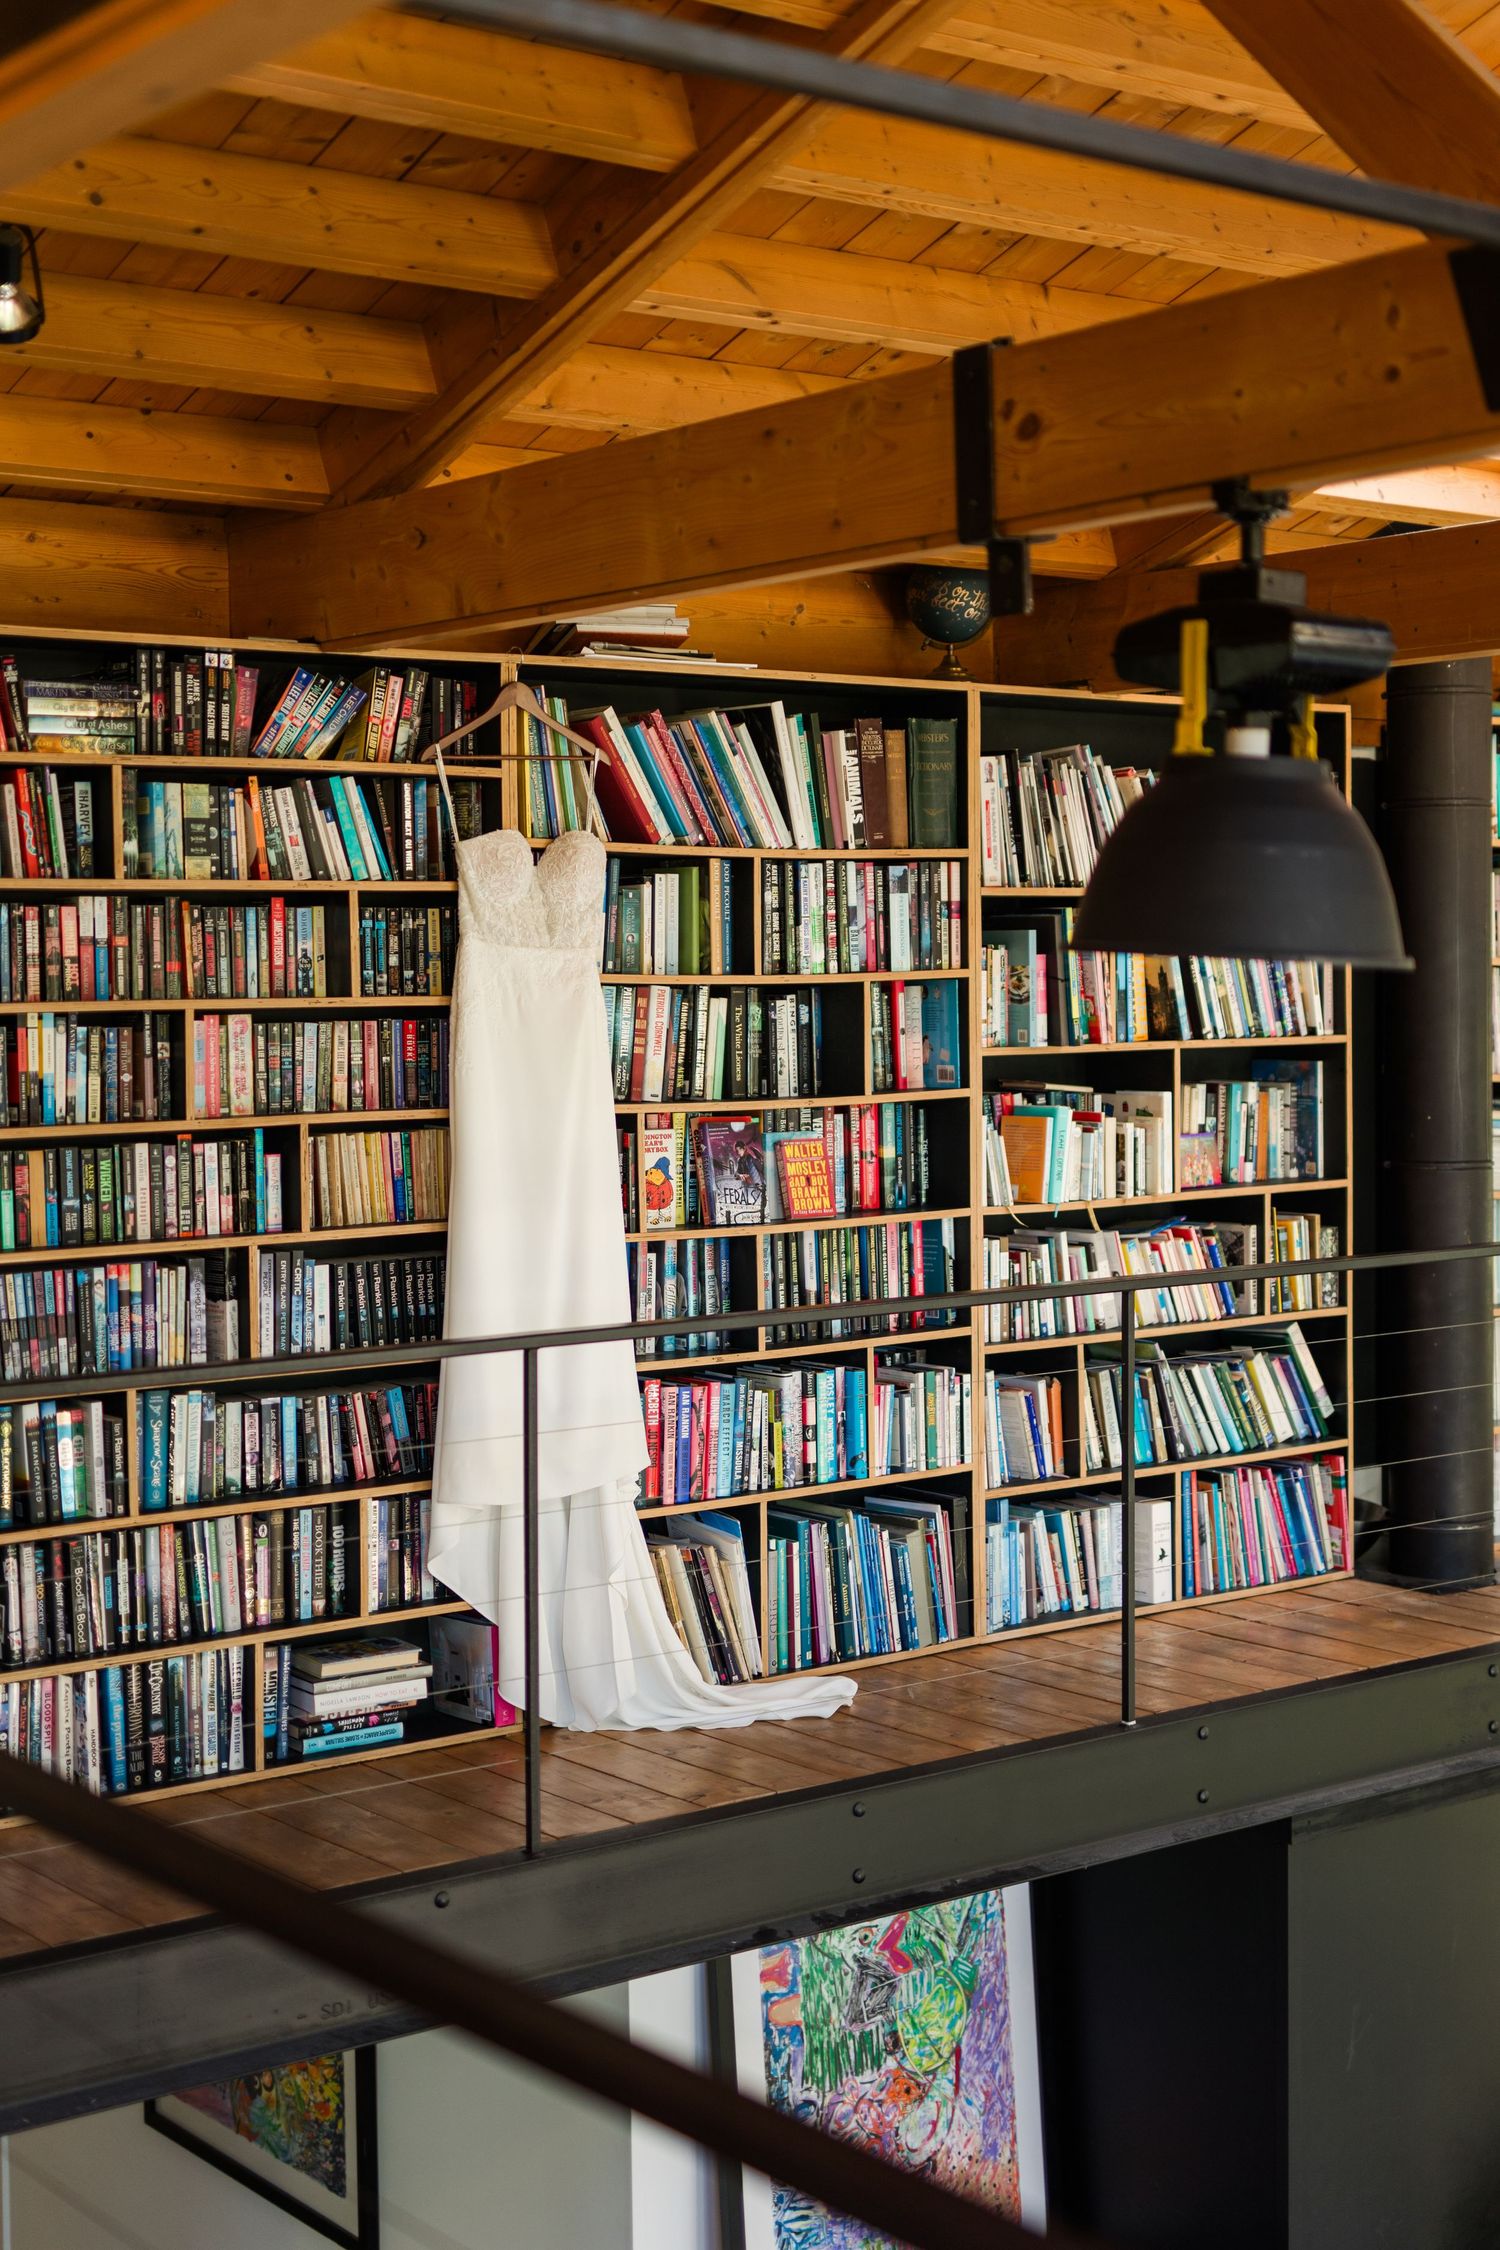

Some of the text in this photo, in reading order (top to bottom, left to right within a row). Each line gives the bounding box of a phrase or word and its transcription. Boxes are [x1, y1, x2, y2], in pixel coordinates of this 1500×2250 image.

[280, 686, 301, 714] LEE CHILD
[295, 692, 318, 720] LEE CHILD
[315, 696, 337, 721] LEE CHILD
[329, 695, 356, 729] LEE CHILD
[372, 688, 385, 717] LEE CHILD
[207, 701, 215, 739] EAGLE STRIKE
[221, 703, 230, 741] SKELETON KEY
[275, 724, 297, 753] PERSUADER
[368, 748, 376, 760] WAY
[369, 732, 378, 748] HARD
[404, 782, 412, 819] GENERATION
[846, 756, 864, 824] ANIMALS
[78, 796, 91, 836] HARVEY
[405, 850, 413, 871] WHITE
[273, 918, 283, 937] JAMES
[274, 937, 284, 965] PATTERSON
[71, 963, 79, 986] HOT
[207, 976, 215, 993] FANG
[69, 1023, 77, 1049] FANNIE
[319, 1023, 327, 1048] BURKE
[652, 988, 666, 1056] PATRICIA CORNWELL
[90, 1035, 99, 1070] ROBERT CRAIS
[257, 1035, 265, 1047] JAMES
[295, 1036, 303, 1060] BURKE
[735, 1005, 744, 1081] The White Lioness
[121, 1058, 129, 1072] DAY
[784, 1142, 824, 1159] WALTER
[826, 1121, 834, 1156] ICE QUEEN
[65, 1150, 74, 1198] STUART MACBRIDE
[86, 1170, 95, 1189] LION
[99, 1160, 111, 1202] WICKED
[787, 1160, 827, 1174] MOSLEY
[789, 1175, 828, 1188] BAD BOY
[153, 1189, 161, 1216] REGINALD
[689, 1189, 697, 1212] HOURS
[723, 1186, 762, 1206] FERALS
[790, 1186, 829, 1199] BRAWLY
[794, 1195, 831, 1210] BROWN
[294, 1267, 302, 1295] CRITIC
[338, 1280, 346, 1311] Rankin
[357, 1278, 366, 1310] Rankin
[374, 1276, 383, 1307] Rankin
[390, 1276, 399, 1307] Rankin
[405, 1274, 414, 1306] Rankin
[417, 1273, 427, 1304] Rankin
[426, 1273, 435, 1304] Rankin
[707, 1274, 715, 1298] BLACK
[645, 1384, 660, 1426] MACBETH
[826, 1375, 834, 1414] MOSLEY
[667, 1391, 676, 1439] IAN RANKIN
[681, 1390, 690, 1438] IAN RANKIN
[722, 1393, 731, 1457] MARCO EFFECT
[113, 1423, 124, 1469] Ian Rankin
[648, 1429, 658, 1440] JO
[31, 1440, 42, 1503] EMANCIPATED
[49, 1445, 59, 1501] VINDICATED
[734, 1441, 743, 1480] MISSOULA
[175, 1537, 187, 1598] SILENT WITNESSES
[314, 1524, 323, 1588] BOOK THIEF
[332, 1525, 346, 1593] 100 HOURS
[36, 1583, 45, 1600] 100
[74, 1567, 87, 1643] Blood Blood
[151, 1574, 160, 1627] CATCH KILLER
[840, 1583, 851, 1616] Animals
[37, 1600, 45, 1625] SOCIETY
[148, 1662, 164, 1716] UP COUNTRY
[43, 1692, 51, 1722] BLOOD
[156, 1735, 166, 1763] NELSON
